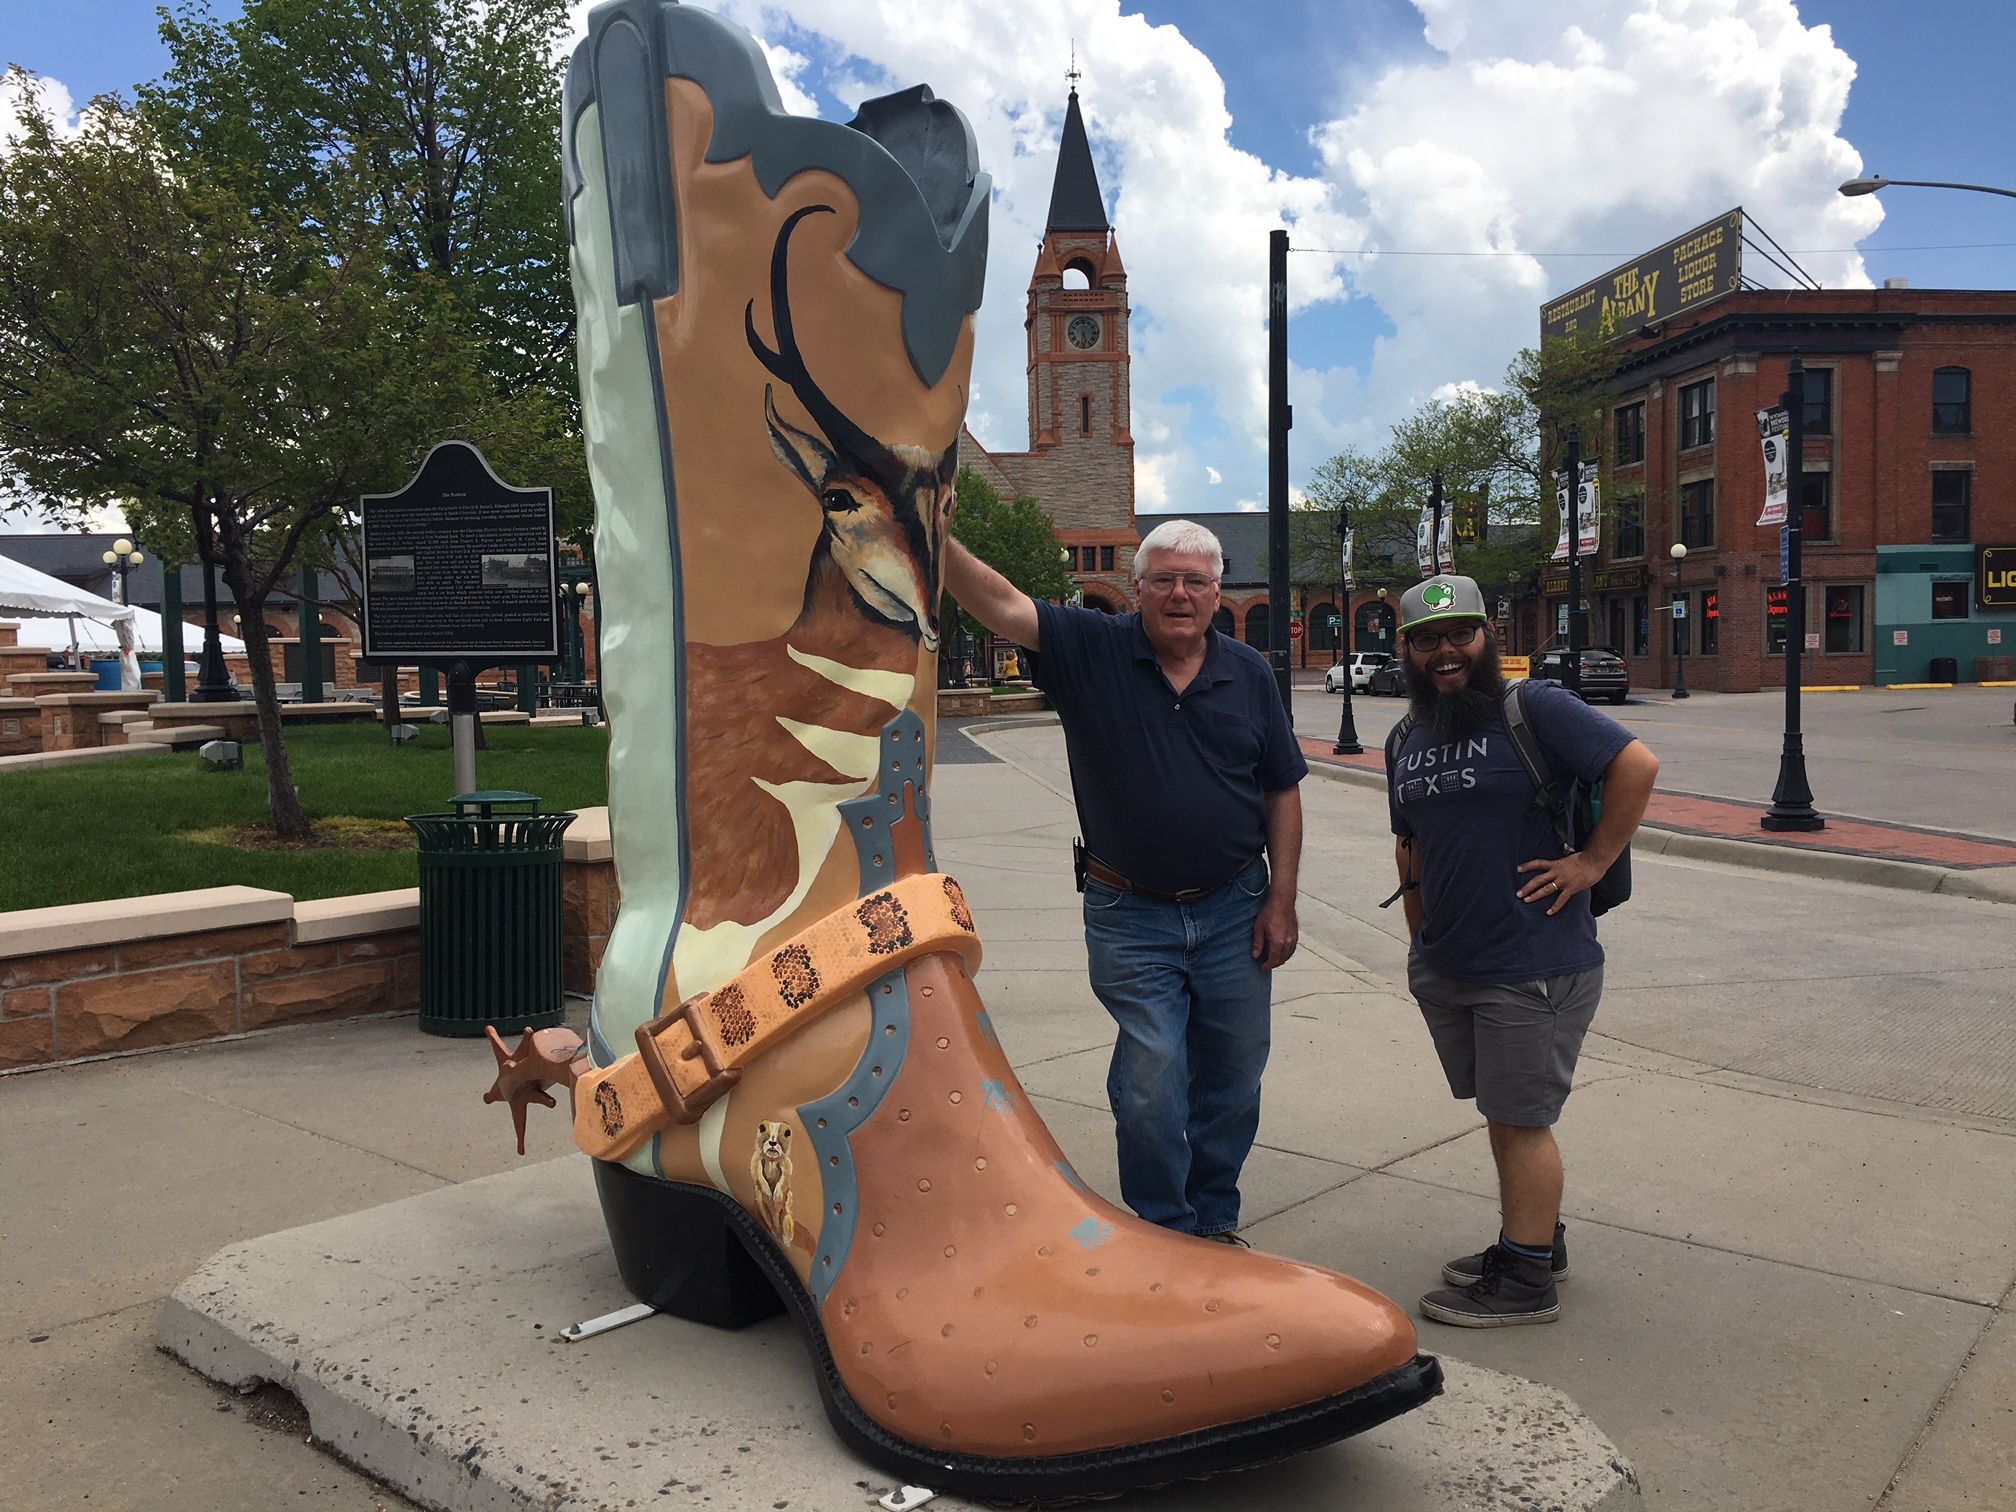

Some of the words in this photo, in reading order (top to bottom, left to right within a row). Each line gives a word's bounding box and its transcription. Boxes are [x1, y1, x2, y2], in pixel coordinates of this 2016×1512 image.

[1673, 226, 1724, 265] PACKAGE
[1613, 267, 1639, 300] THE
[1678, 252, 1717, 283] LIQUOR
[1598, 270, 1661, 336] ALBANY
[1680, 274, 1714, 304] STORE
[1547, 289, 1597, 324] RESTAURANT
[1290, 626, 1302, 634] TOP
[1329, 616, 1336, 626] P
[1396, 768, 1476, 804] TXS
